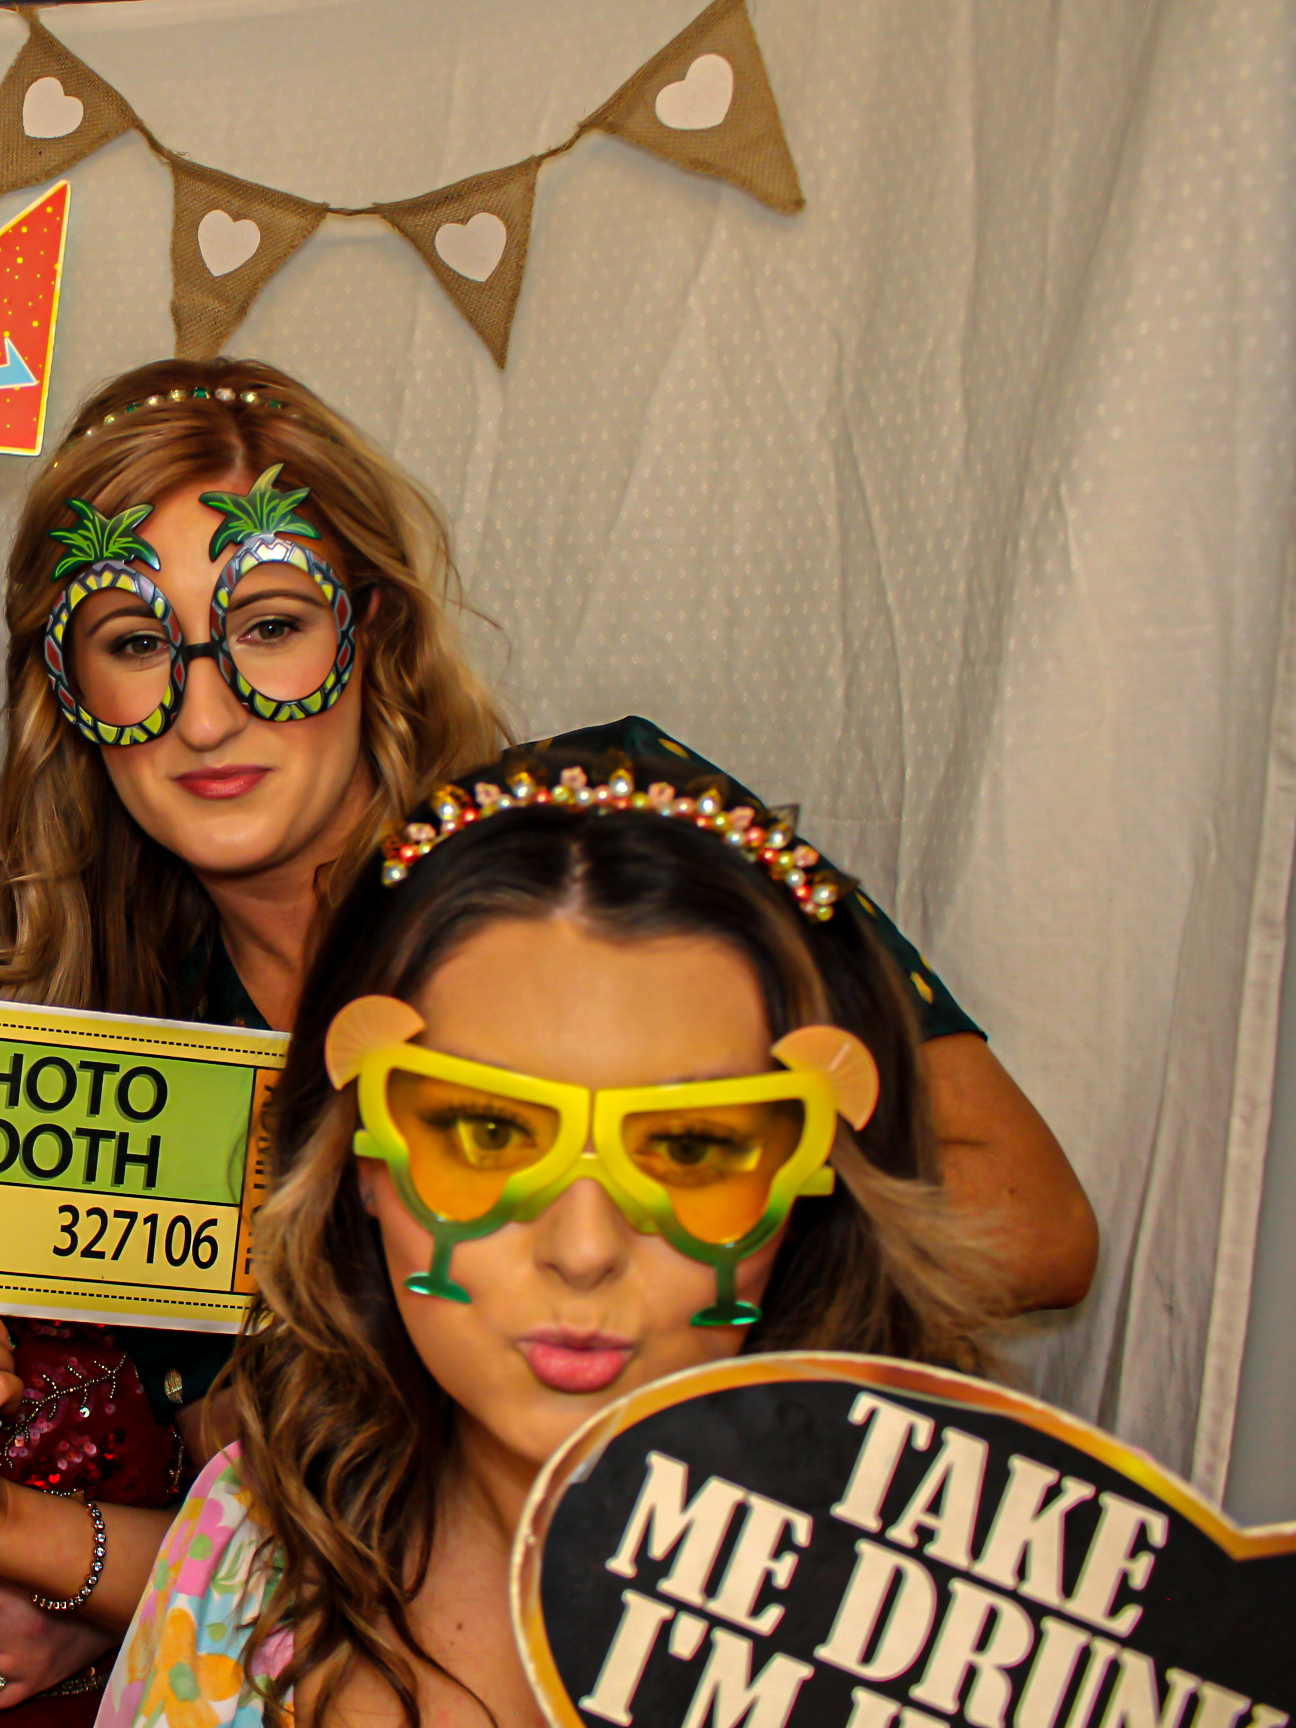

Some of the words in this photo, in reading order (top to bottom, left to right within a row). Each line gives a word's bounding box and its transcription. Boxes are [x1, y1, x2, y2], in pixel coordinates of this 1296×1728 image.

[53, 1204, 219, 1270] 327106
[605, 1450, 814, 1636] ME
[830, 1391, 1168, 1637] TAKE
[578, 1588, 815, 1728] I'M
